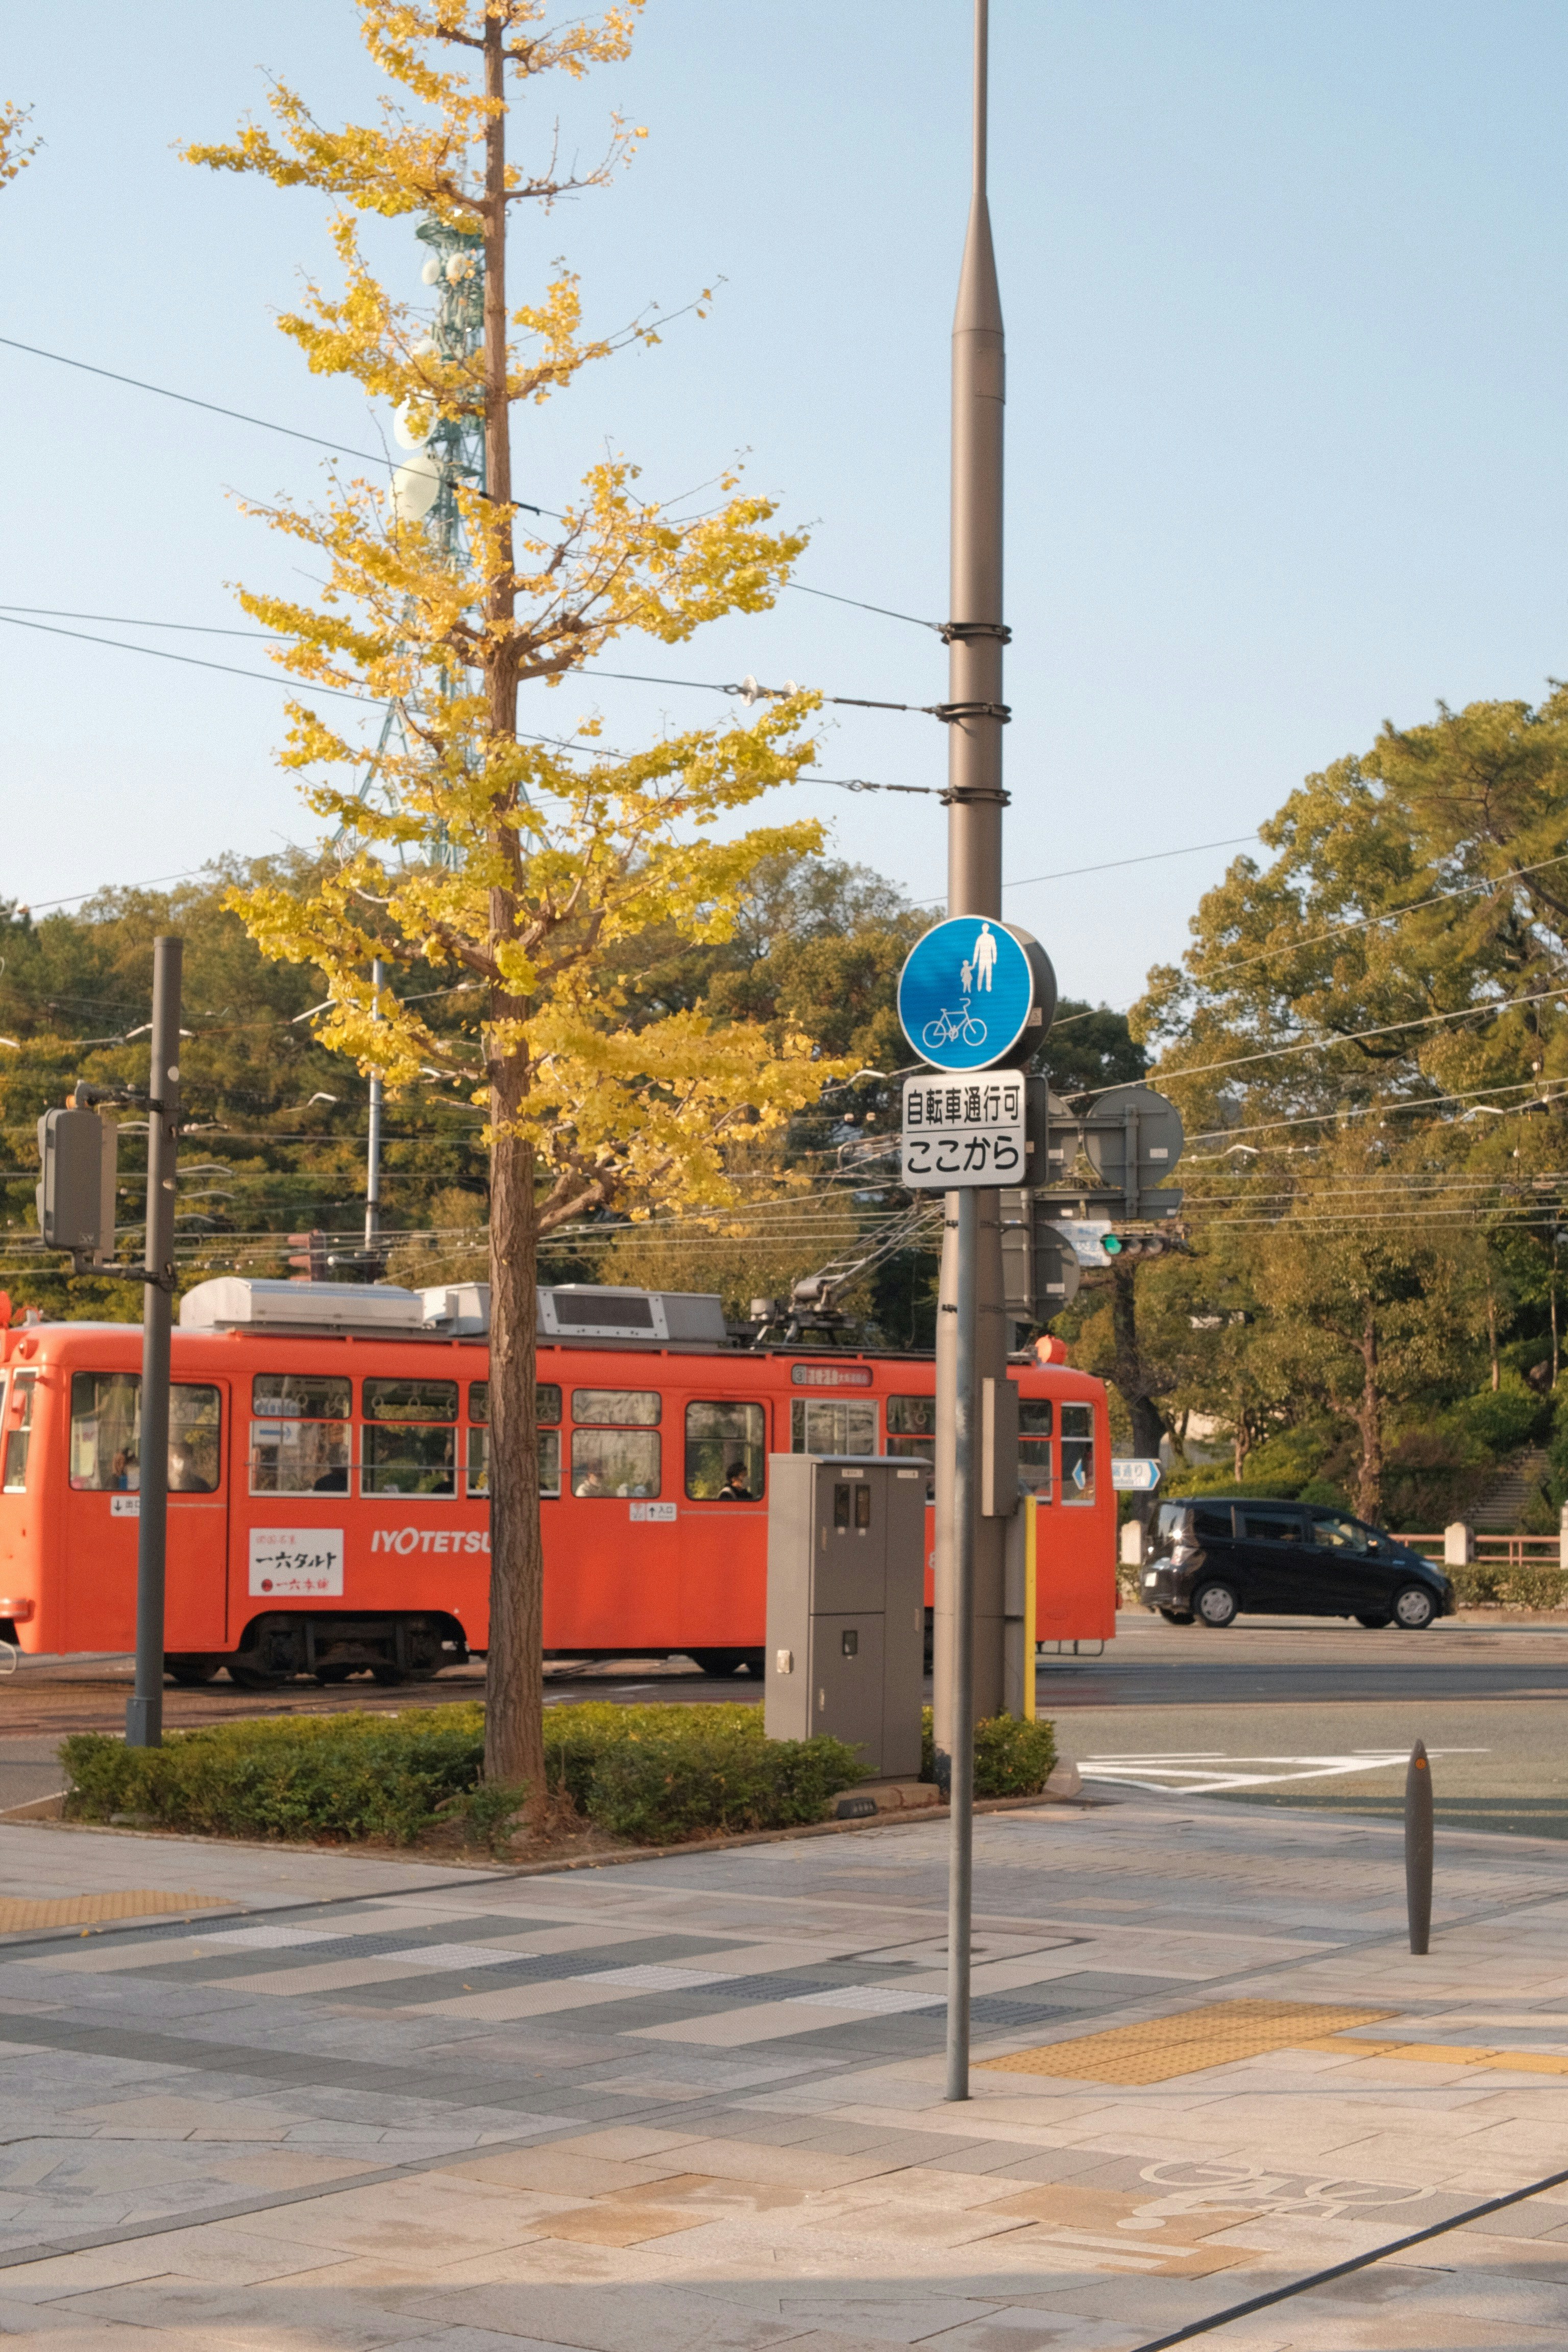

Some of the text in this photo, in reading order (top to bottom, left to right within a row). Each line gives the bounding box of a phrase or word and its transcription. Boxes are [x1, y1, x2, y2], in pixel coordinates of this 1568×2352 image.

[908, 1085, 1020, 1124] 自転車通行可
[908, 1135, 1019, 1173] ここから
[658, 1505, 673, 1514] 入口
[256, 1551, 337, 1570] 一六タルト
